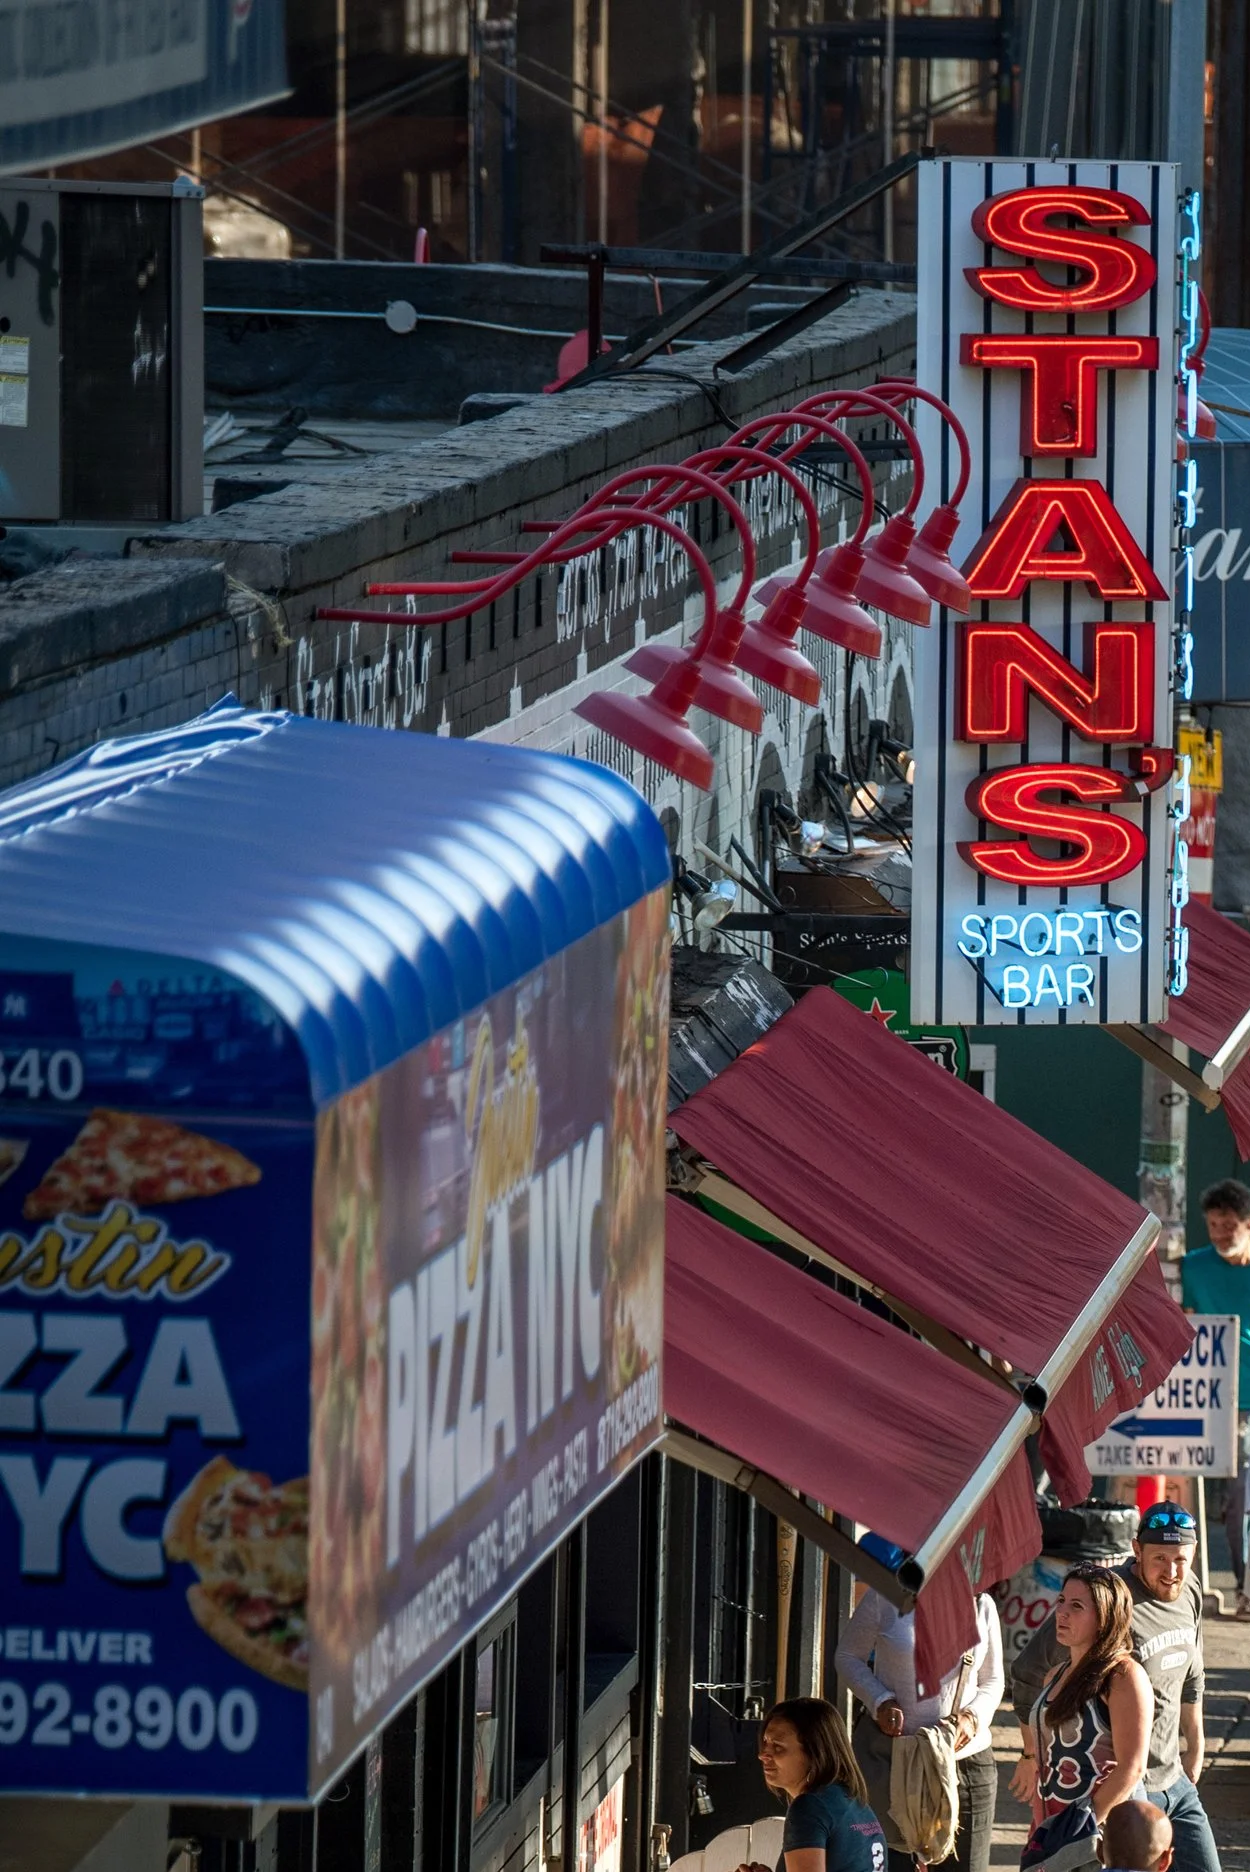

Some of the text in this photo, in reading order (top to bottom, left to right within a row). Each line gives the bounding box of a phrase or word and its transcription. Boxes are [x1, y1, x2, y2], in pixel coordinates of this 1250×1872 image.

[957, 184, 1174, 887] STAN'S
[958, 907, 1143, 958] SPORTS
[1003, 964, 1095, 1007] BAR
[0, 1048, 84, 1100] 40
[387, 1121, 604, 1570] PIZZA NYC
[1181, 1325, 1227, 1367] CK
[1154, 1378, 1222, 1409] CHECK
[1096, 1446, 1132, 1466] TAKE
[1136, 1446, 1163, 1466] KEY
[1187, 1446, 1216, 1466] YOU
[503, 1487, 528, 1572] HERO
[531, 1454, 559, 1538] WINGS
[563, 1427, 588, 1506] PASTA
[0, 1629, 152, 1665] ELIVER
